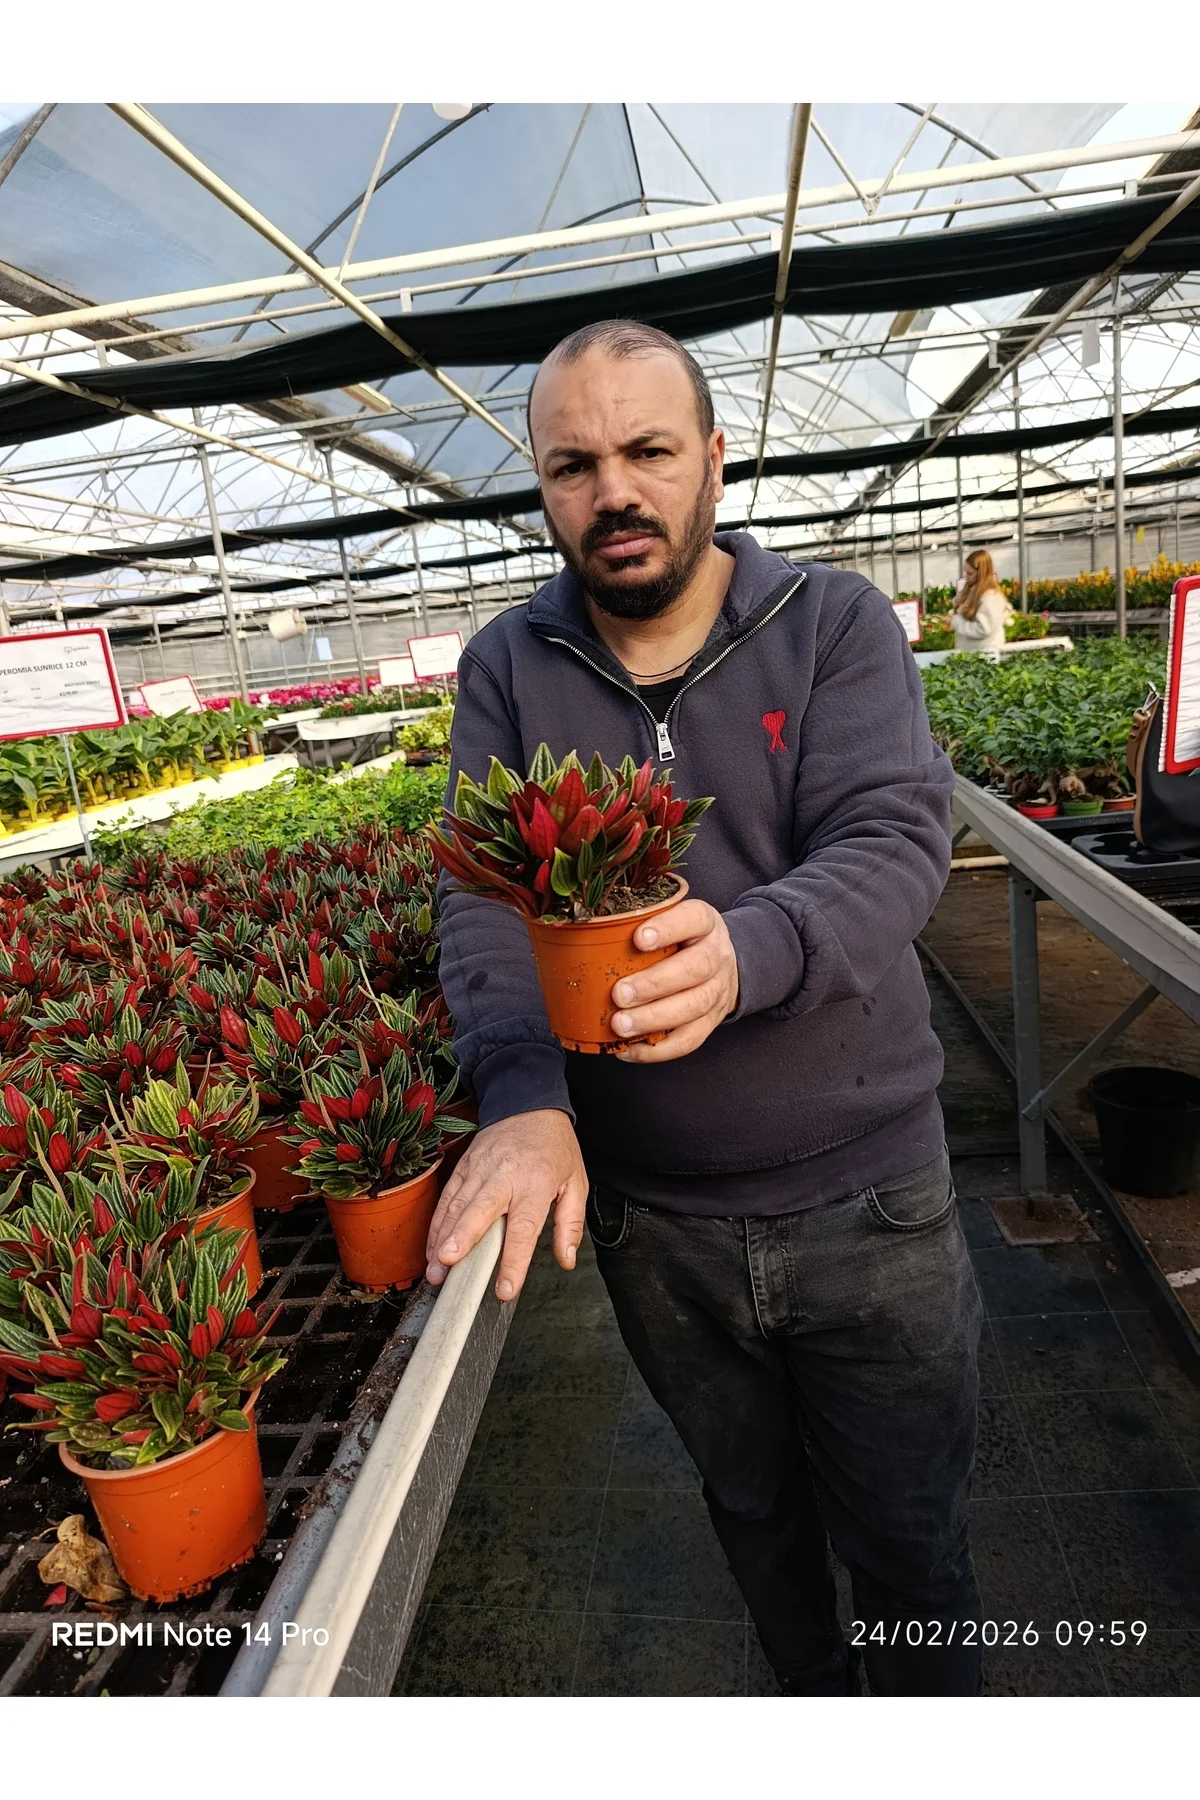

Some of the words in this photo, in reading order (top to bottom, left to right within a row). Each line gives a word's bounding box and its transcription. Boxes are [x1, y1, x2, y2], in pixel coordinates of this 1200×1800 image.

[33, 663, 63, 672] SUNRICE
[65, 661, 74, 669] 12
[75, 660, 88, 668] CM
